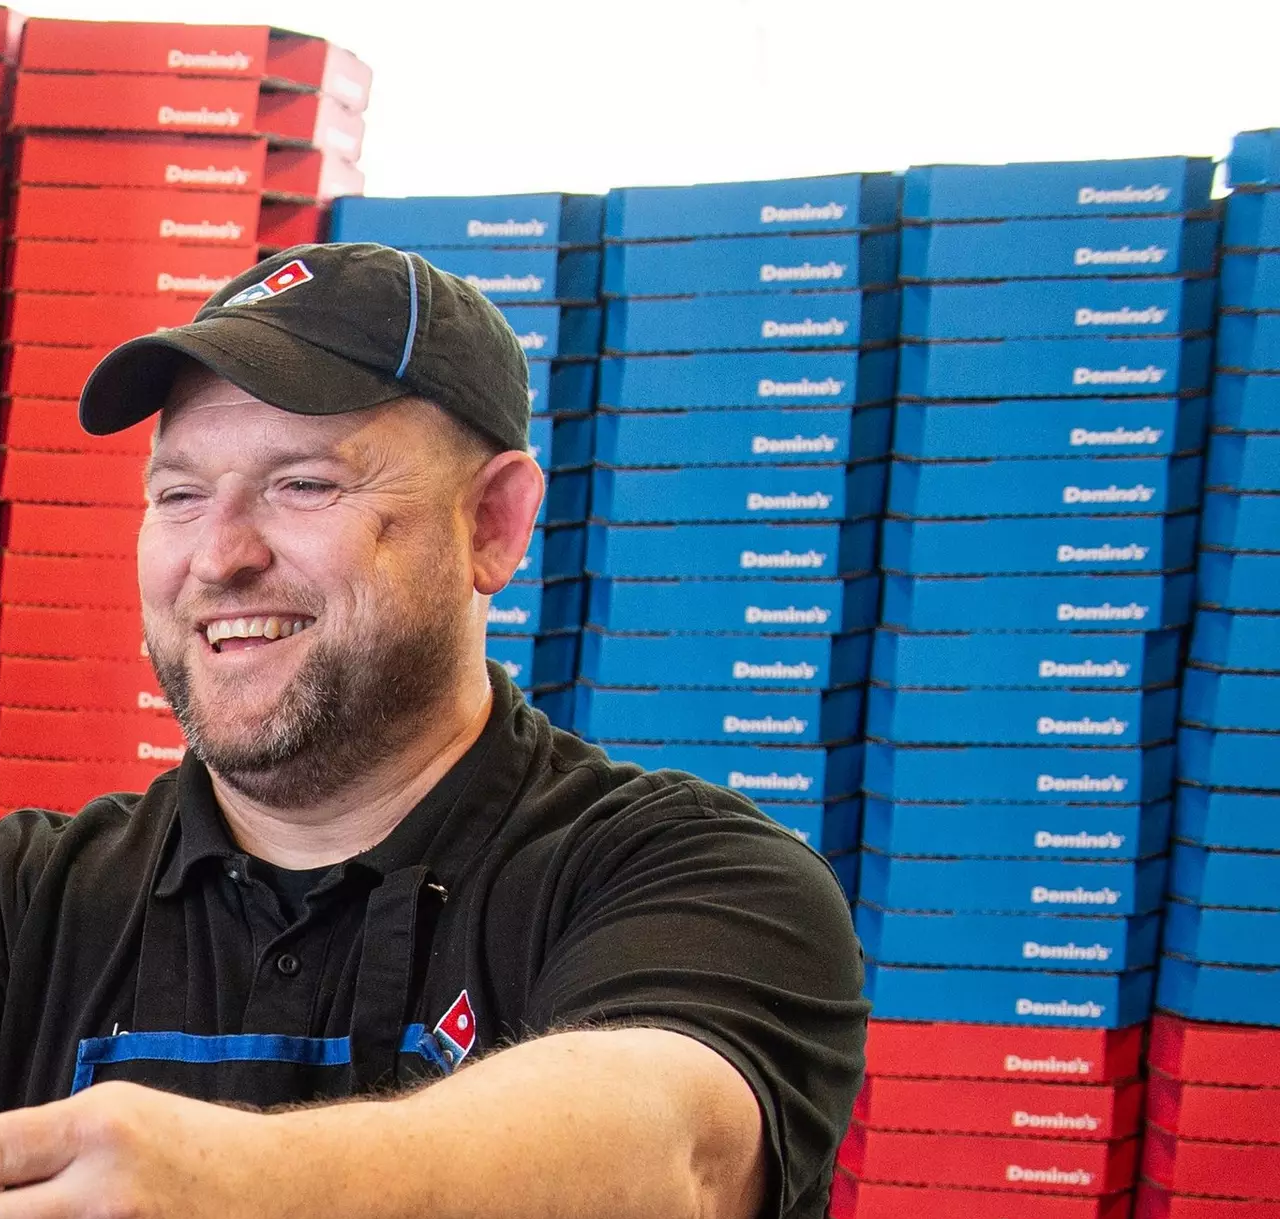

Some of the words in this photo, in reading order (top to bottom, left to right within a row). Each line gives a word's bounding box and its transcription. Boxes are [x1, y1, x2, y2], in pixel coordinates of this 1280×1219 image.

[168, 50, 249, 69] Domino's
[158, 107, 240, 126] Domino's
[165, 165, 248, 184] Domino's
[1077, 185, 1170, 204] Domino's
[760, 202, 846, 223] Domino's
[160, 220, 244, 239] Domino's
[467, 219, 547, 237] Domino's
[1074, 245, 1168, 265] Domino's
[760, 261, 847, 282] Domino's
[1074, 306, 1168, 326] Domino's
[761, 317, 848, 338] Domino's
[1072, 365, 1167, 385] Domino's
[757, 377, 845, 397] Domino's
[751, 434, 839, 454] Domino's
[1069, 426, 1164, 446] Domino's
[746, 491, 833, 511] Domino's
[1062, 484, 1155, 504] Domino's
[740, 550, 827, 569] Domino's
[1056, 543, 1149, 562] Domino's
[744, 606, 831, 624] Domino's
[1056, 602, 1149, 621] Domino's
[732, 661, 818, 679] Domino's
[1038, 660, 1130, 678] Domino's
[723, 715, 808, 734] Domino's
[1036, 716, 1129, 735] Domino's
[728, 771, 814, 791] Domino's
[1036, 774, 1128, 792] Domino's
[1034, 831, 1125, 849] Domino's
[1031, 886, 1121, 904] Domino's
[1022, 941, 1112, 961] Domino's
[1015, 998, 1105, 1018] Domino's
[1004, 1055, 1093, 1074] Domino's
[1012, 1111, 1101, 1130] Domino's
[1006, 1165, 1094, 1185] Domino's
